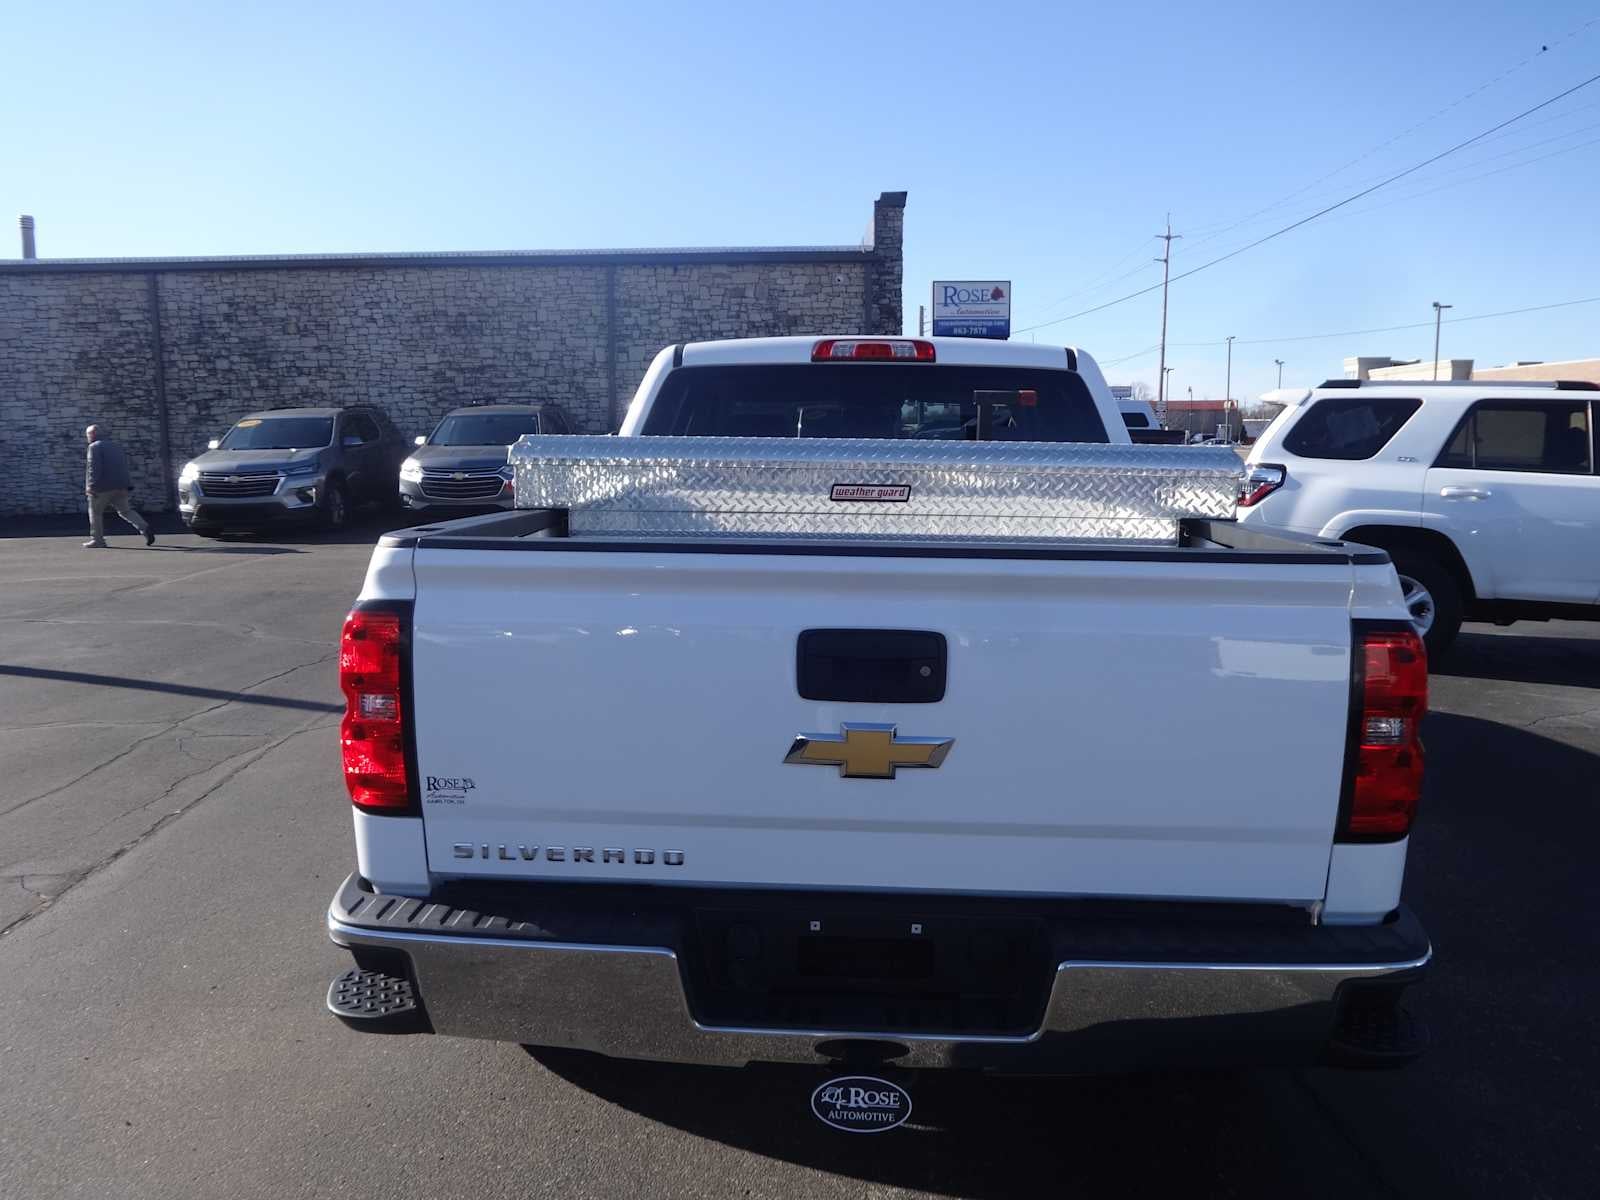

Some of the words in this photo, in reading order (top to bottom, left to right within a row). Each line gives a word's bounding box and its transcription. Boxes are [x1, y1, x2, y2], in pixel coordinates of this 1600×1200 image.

[943, 285, 991, 307] ROSE
[835, 487, 876, 497] weather
[877, 488, 906, 498] guard
[426, 776, 460, 791] ROSE
[453, 842, 684, 866] SILVERADO
[848, 1087, 900, 1108] ROSE
[828, 1110, 896, 1122] AUTOMOTIVE
